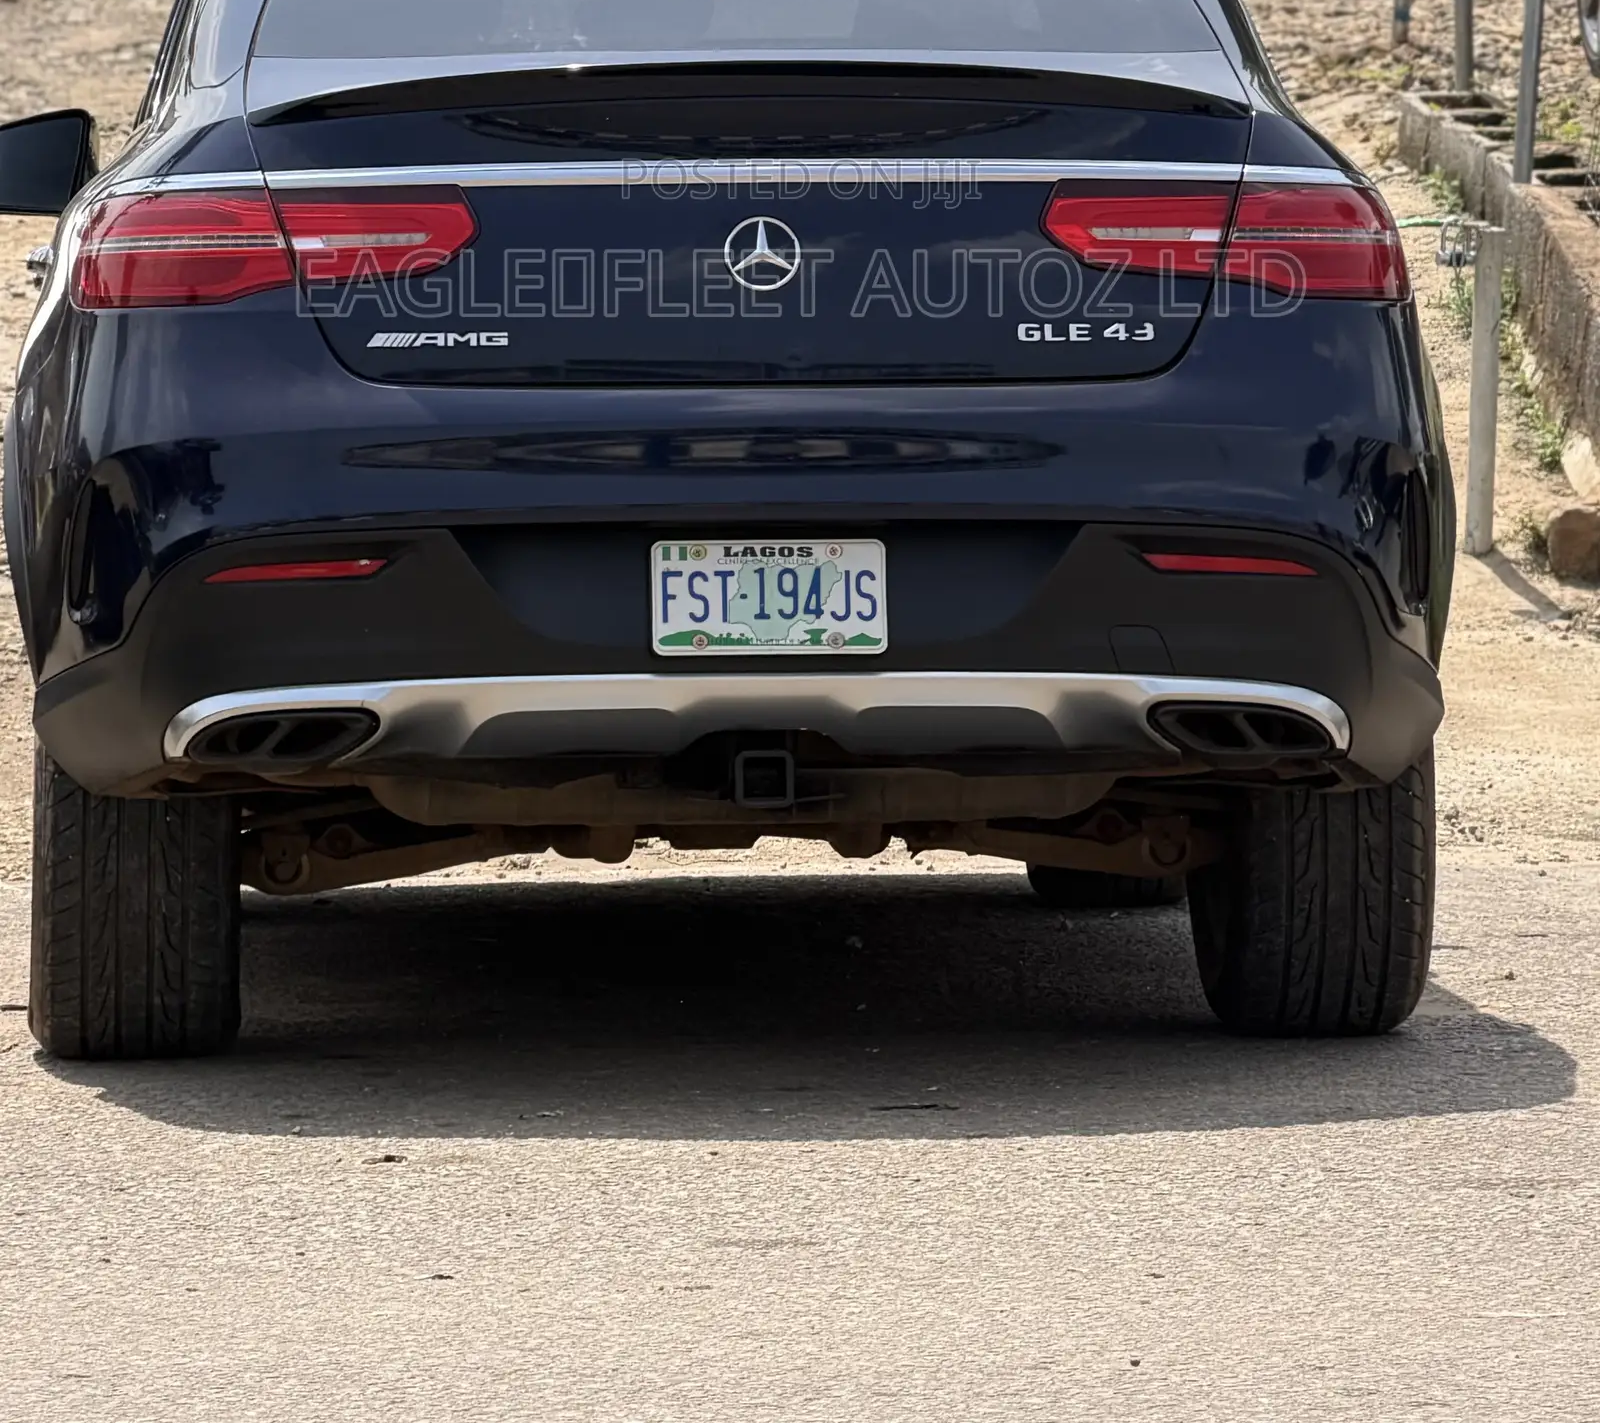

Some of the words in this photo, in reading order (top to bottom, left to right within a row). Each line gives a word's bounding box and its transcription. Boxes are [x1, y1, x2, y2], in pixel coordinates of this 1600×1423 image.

[1017, 323, 1092, 342] GLE
[1103, 322, 1155, 342] 43
[723, 546, 814, 558] LAGOS
